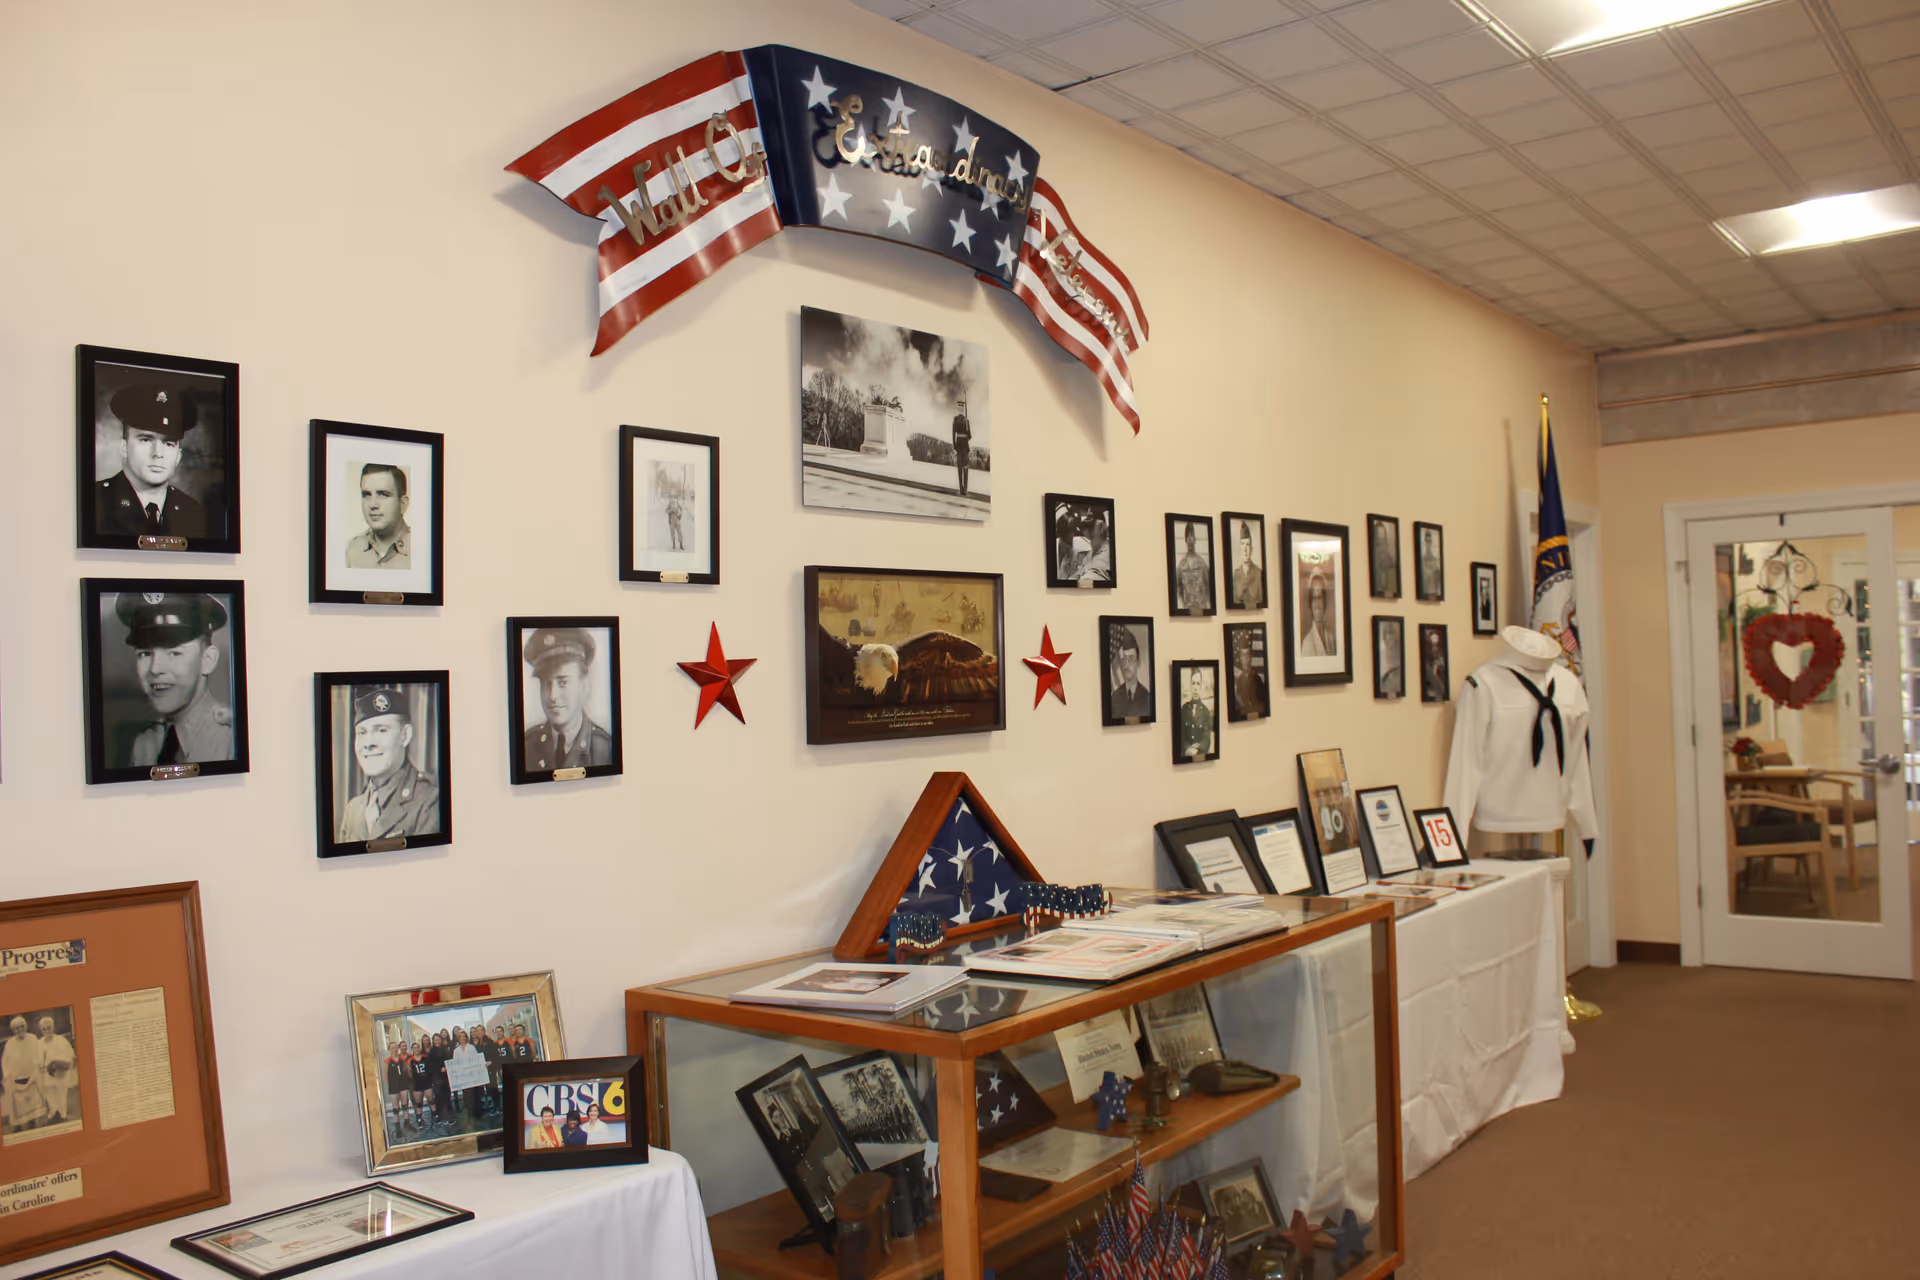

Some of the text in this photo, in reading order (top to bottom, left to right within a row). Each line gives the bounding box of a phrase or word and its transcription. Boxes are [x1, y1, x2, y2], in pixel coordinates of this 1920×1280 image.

[596, 145, 709, 245] Wall
[1426, 819, 1453, 848] 15
[2, 946, 82, 969] Progress
[526, 1081, 626, 1118] CBS 6
[13, 1193, 56, 1211] Caroline
